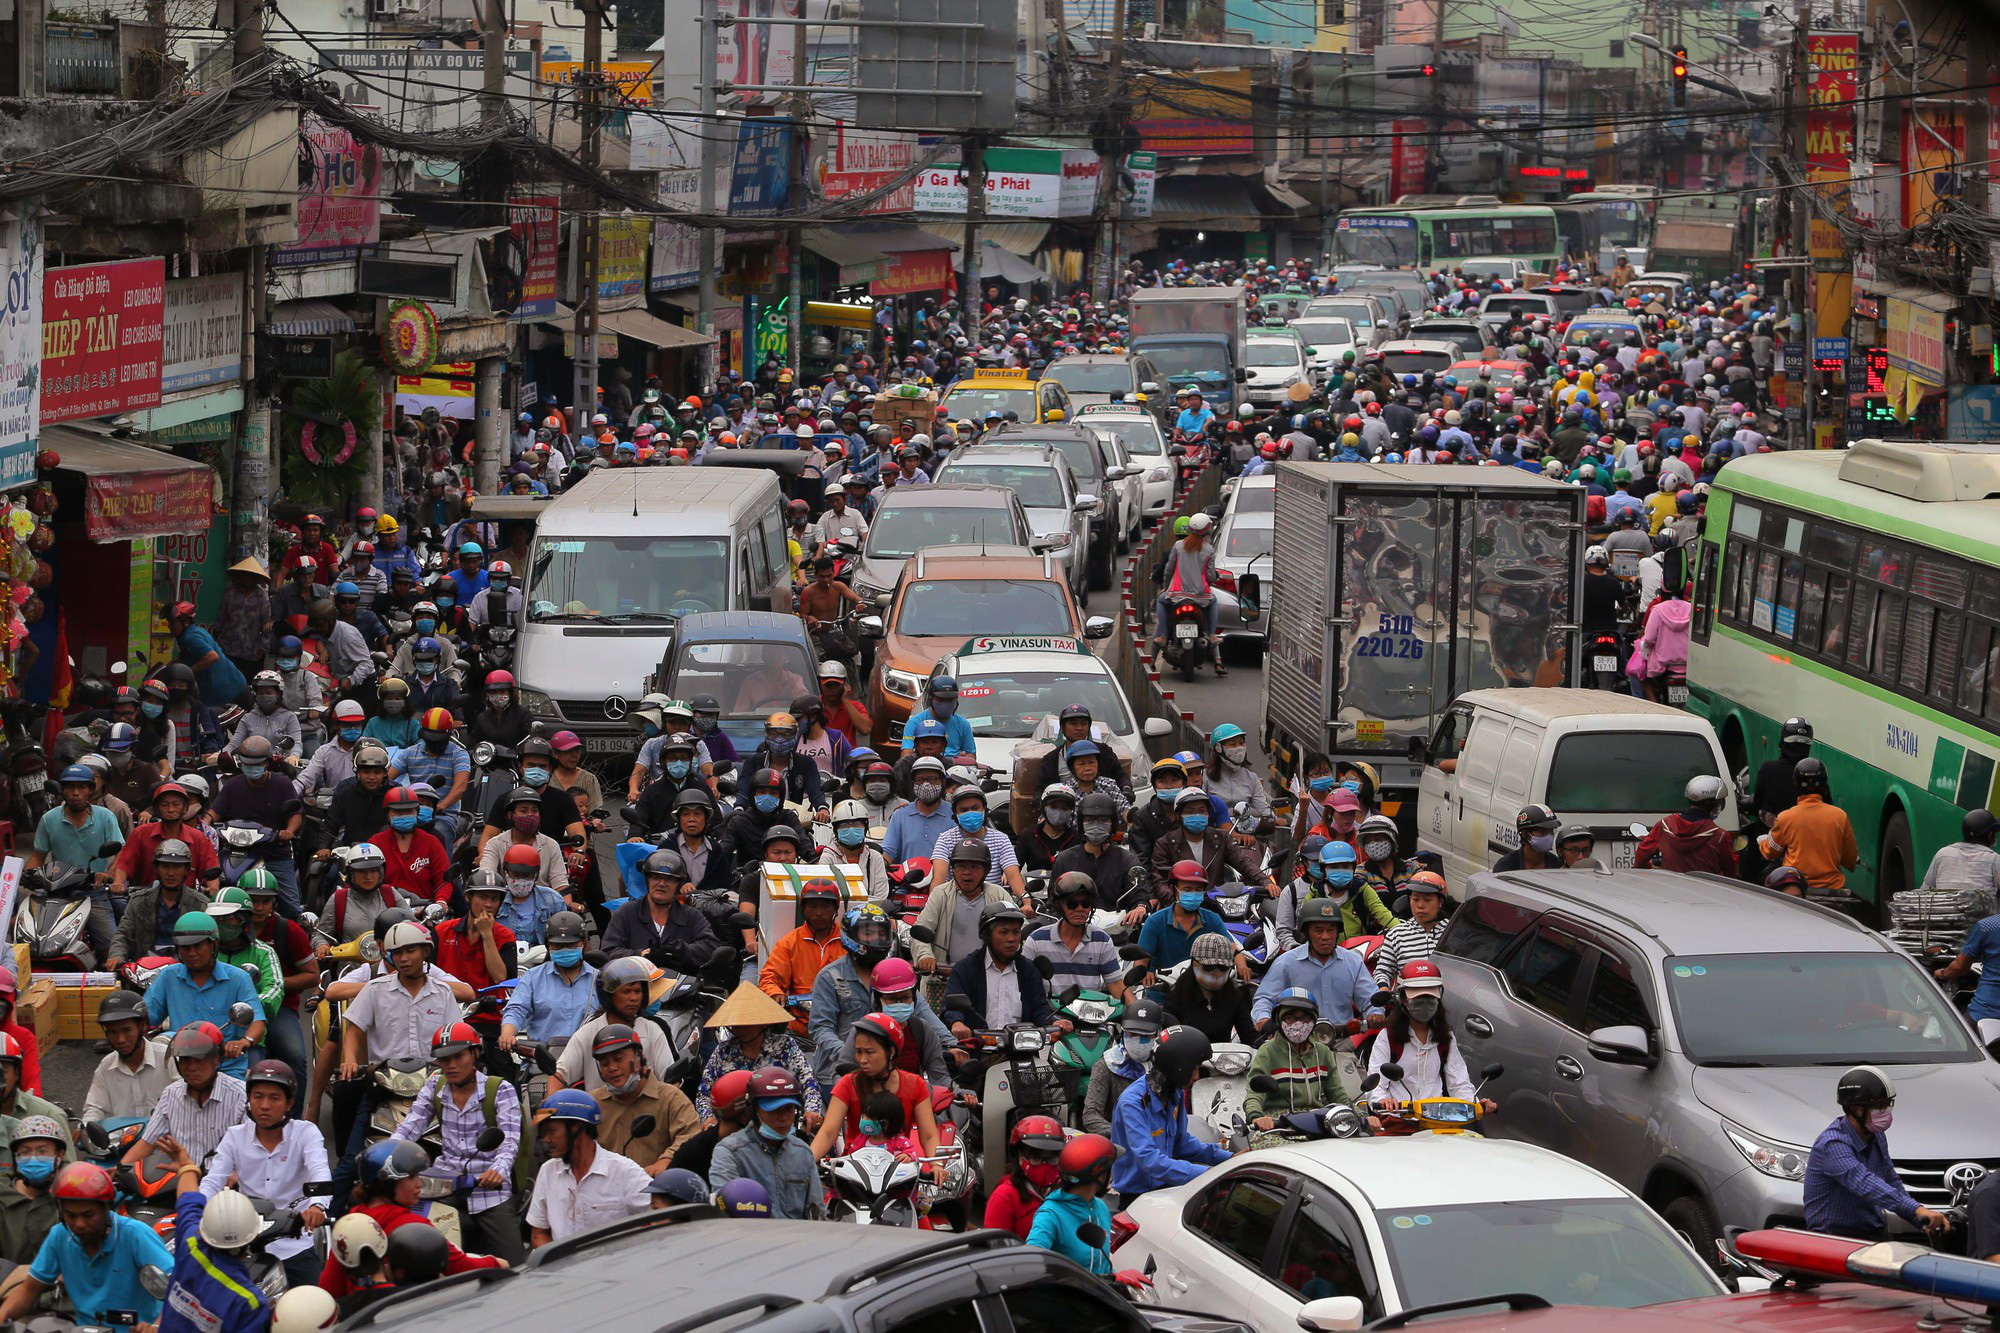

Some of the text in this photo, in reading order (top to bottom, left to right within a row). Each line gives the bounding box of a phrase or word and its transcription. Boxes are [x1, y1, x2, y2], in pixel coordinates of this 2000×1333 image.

[337, 54, 376, 67] TRUNG
[381, 52, 406, 67] TÂM
[413, 55, 441, 68] MAY
[447, 55, 463, 68] ĐO
[847, 139, 865, 168] NÓN
[868, 136, 886, 167] BẢO
[931, 173, 948, 186] Ga
[1001, 176, 1030, 190] Phát
[54, 270, 110, 302] Cửa Hàng Đồ Điện
[124, 290, 133, 308] LED
[86, 304, 118, 353] TÂN
[122, 327, 132, 346] LED
[1785, 356, 1803, 366] 592
[120, 364, 131, 382] LED
[132, 361, 148, 381] TRANG
[978, 369, 1024, 377] Vinataxi
[165, 529, 208, 565] PHỞ
[1379, 614, 1413, 635] 51D
[1000, 638, 1075, 650] VINASUN TAXI
[1357, 636, 1423, 659] 220.26
[962, 688, 990, 696] 12616
